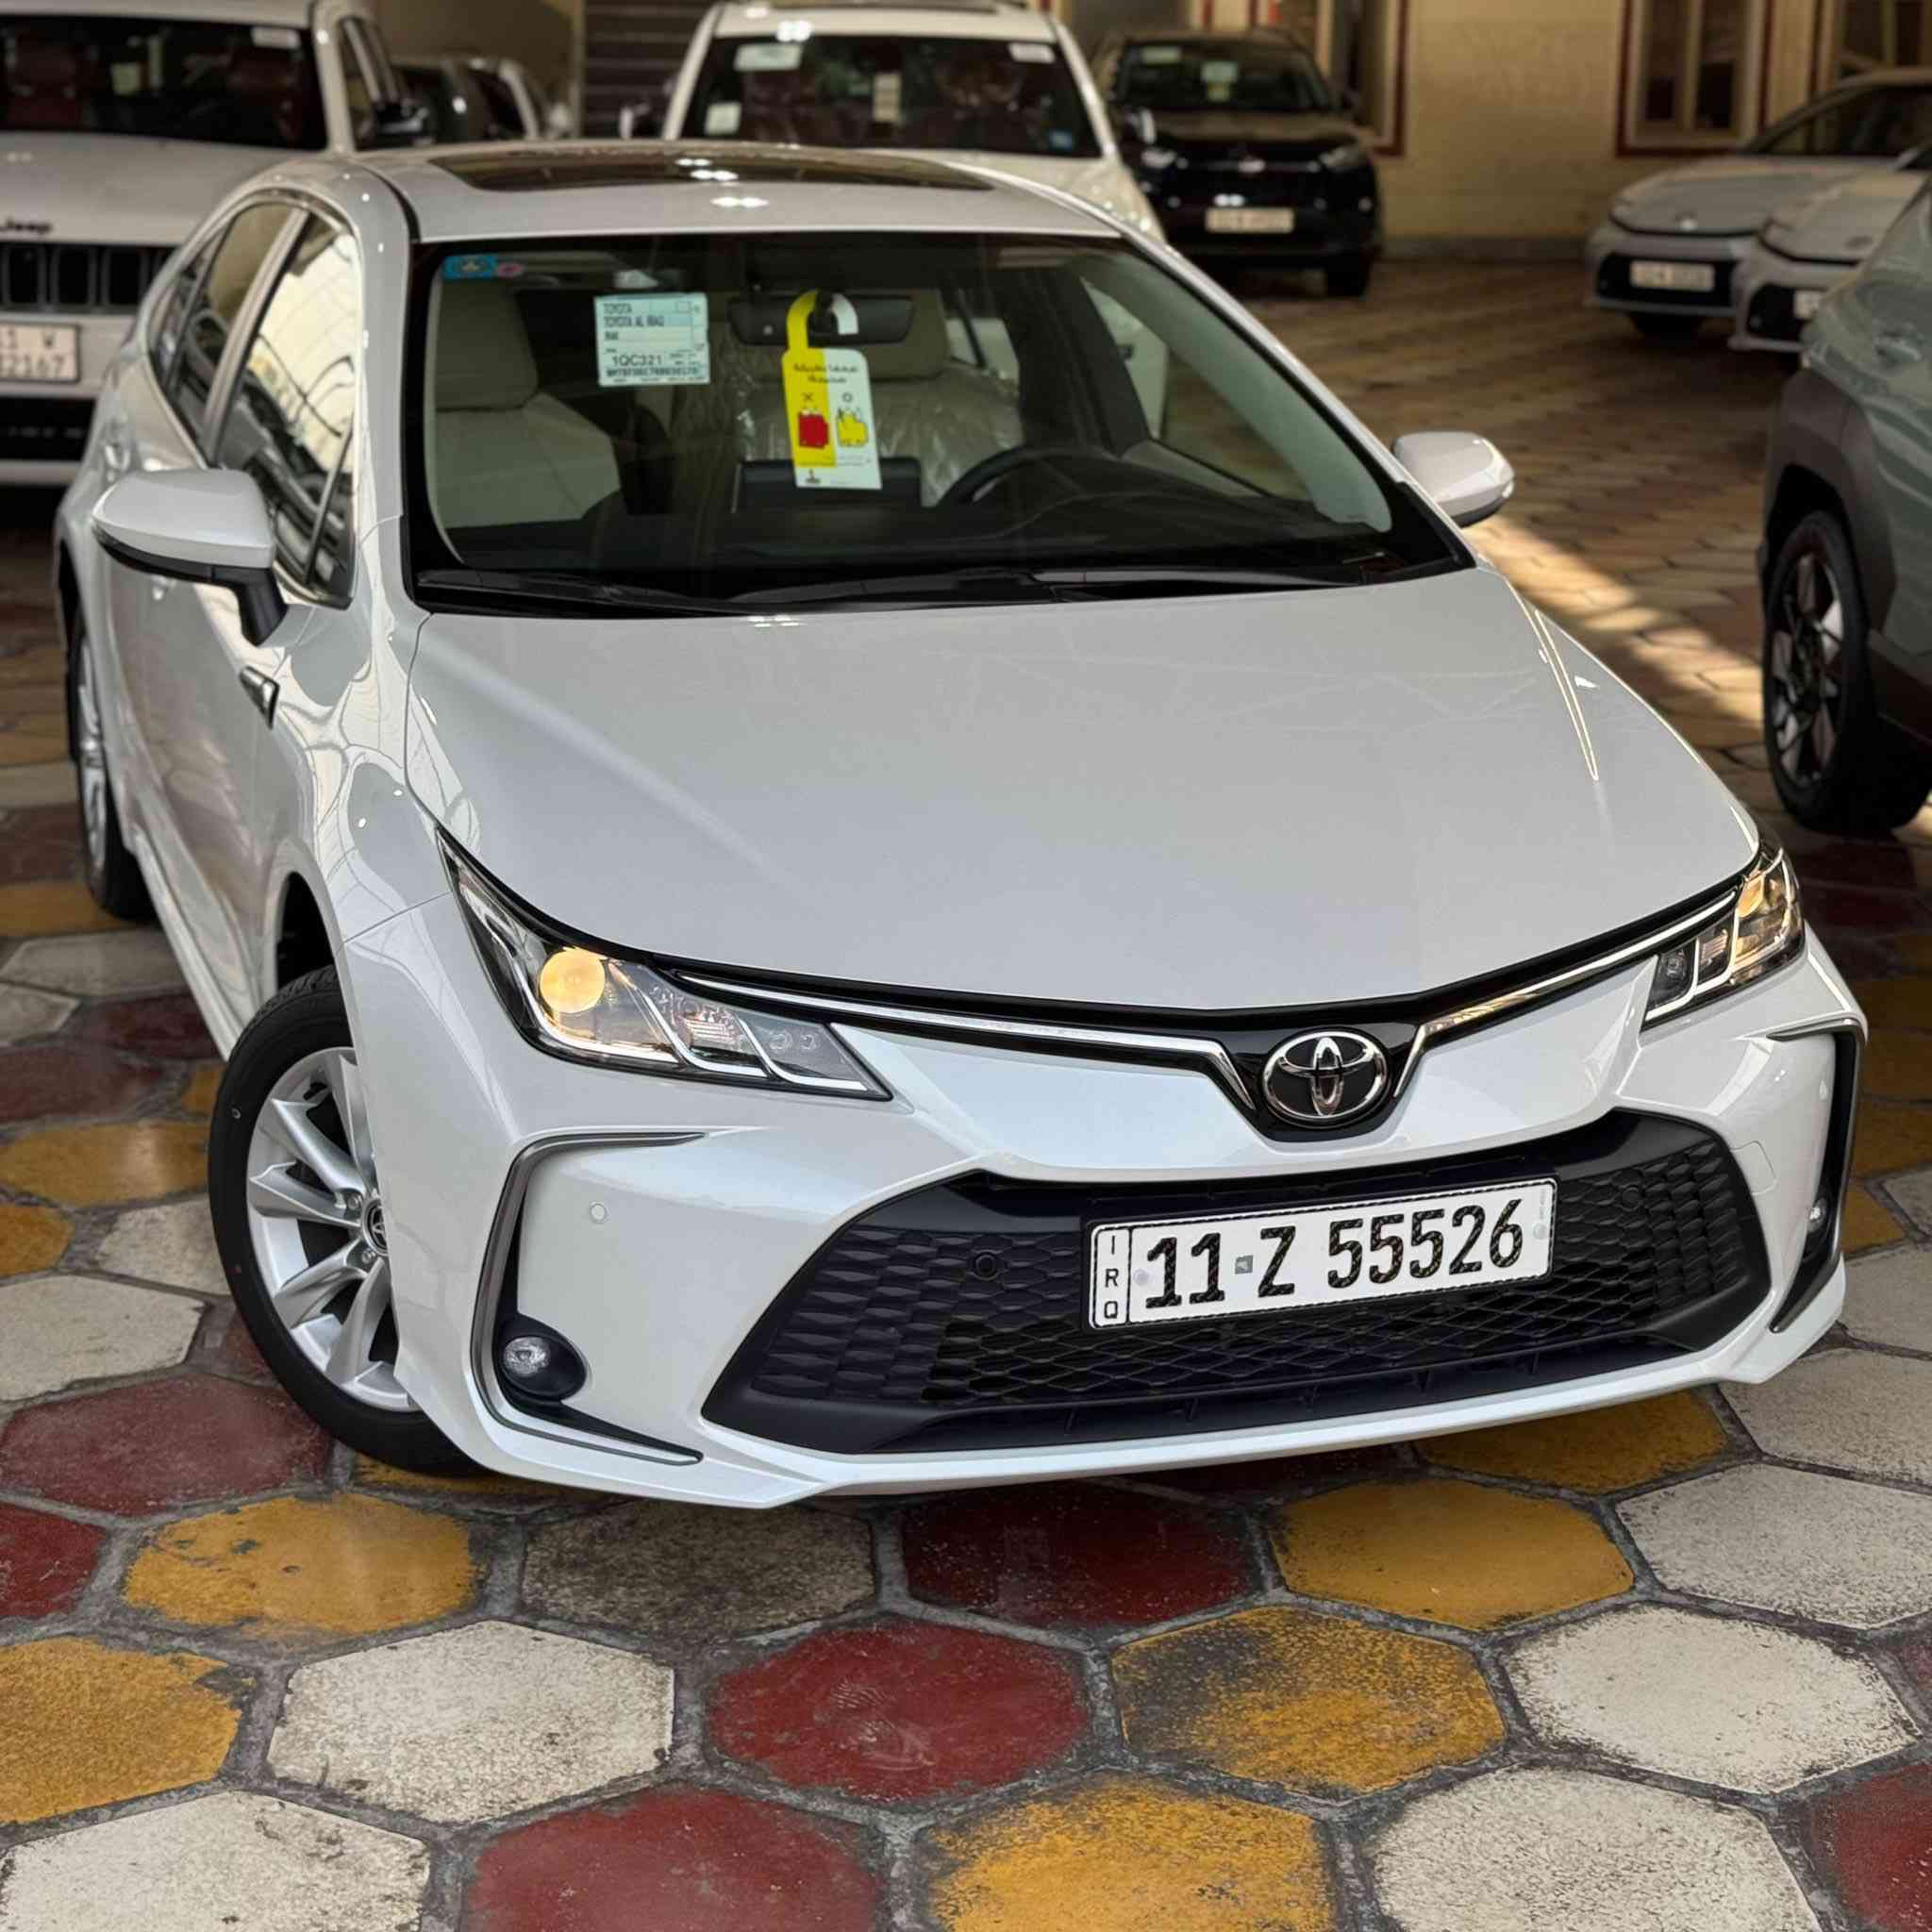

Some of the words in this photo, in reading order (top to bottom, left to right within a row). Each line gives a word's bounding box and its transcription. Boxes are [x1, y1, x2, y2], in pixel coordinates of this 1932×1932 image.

[611, 354, 662, 366] 1QC321
[1103, 1234, 1120, 1320] IRQ
[1145, 1232, 1226, 1309] 11
[1257, 1225, 1297, 1298] Z
[1326, 1198, 1524, 1290] 55526
